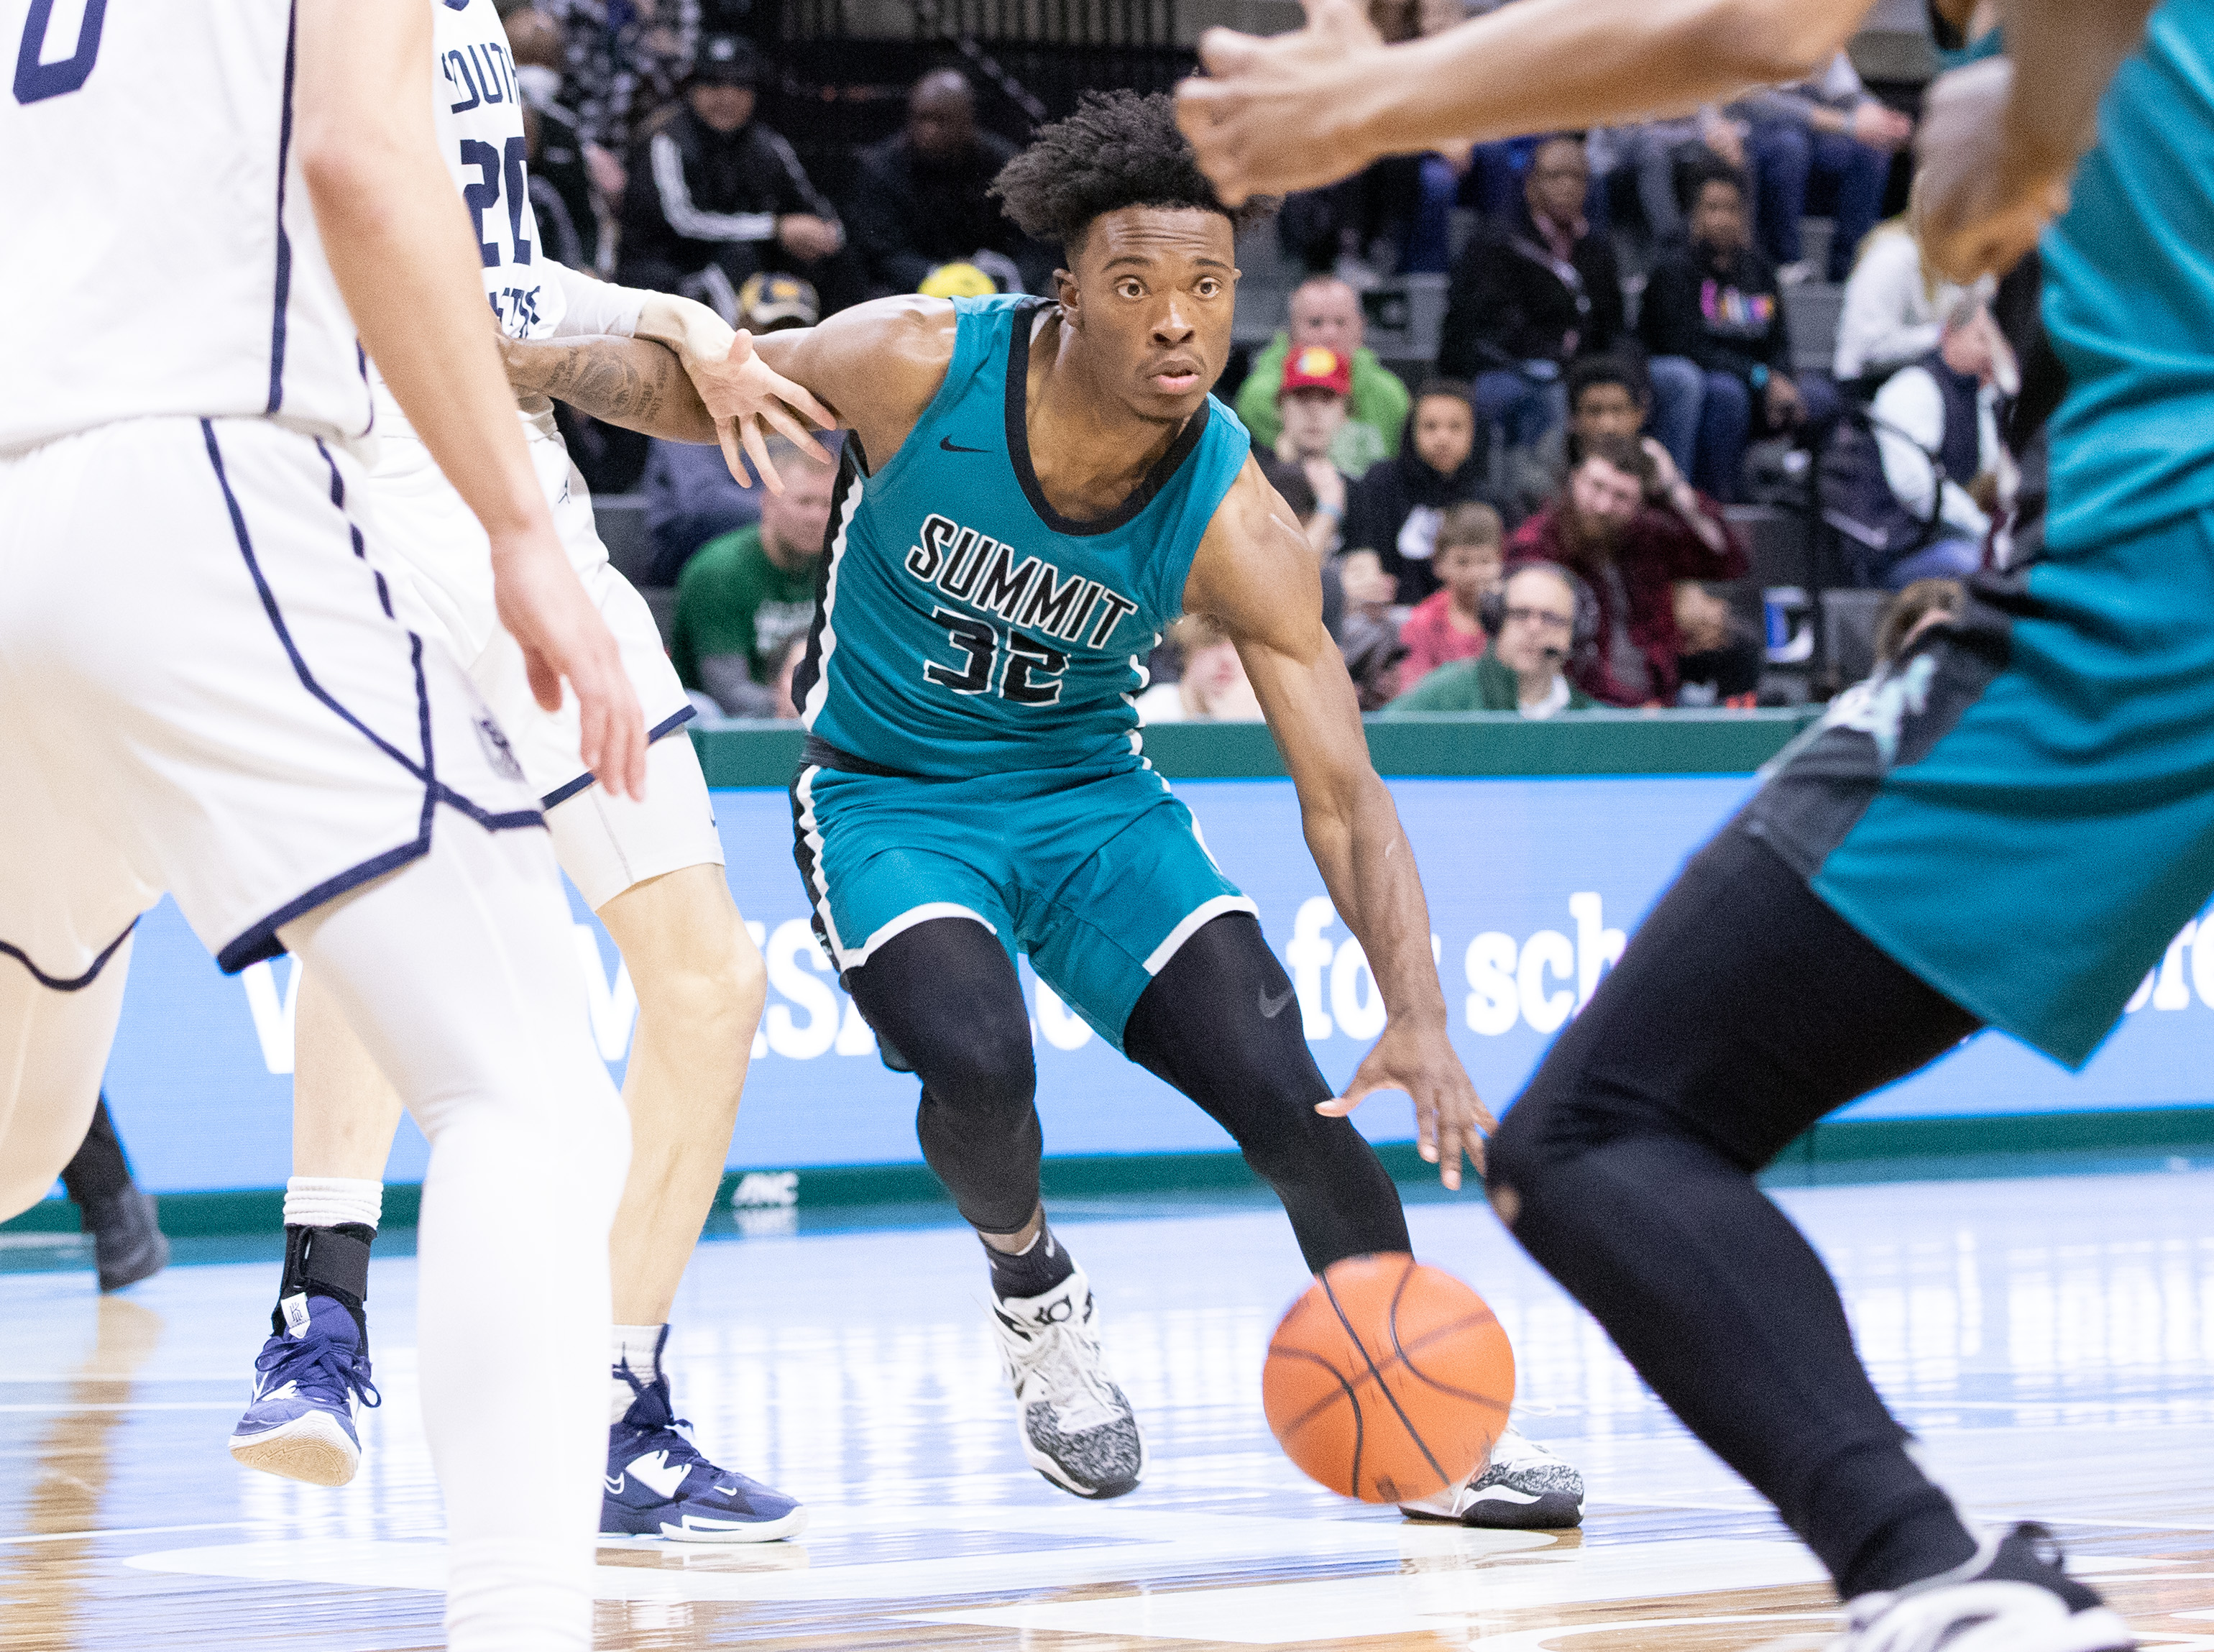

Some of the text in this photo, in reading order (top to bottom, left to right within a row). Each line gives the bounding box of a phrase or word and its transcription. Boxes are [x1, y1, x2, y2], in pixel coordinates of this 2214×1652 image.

[904, 513, 1139, 650] SUMMIT
[923, 605, 1072, 707] 32
[1285, 896, 1441, 1040] fo
